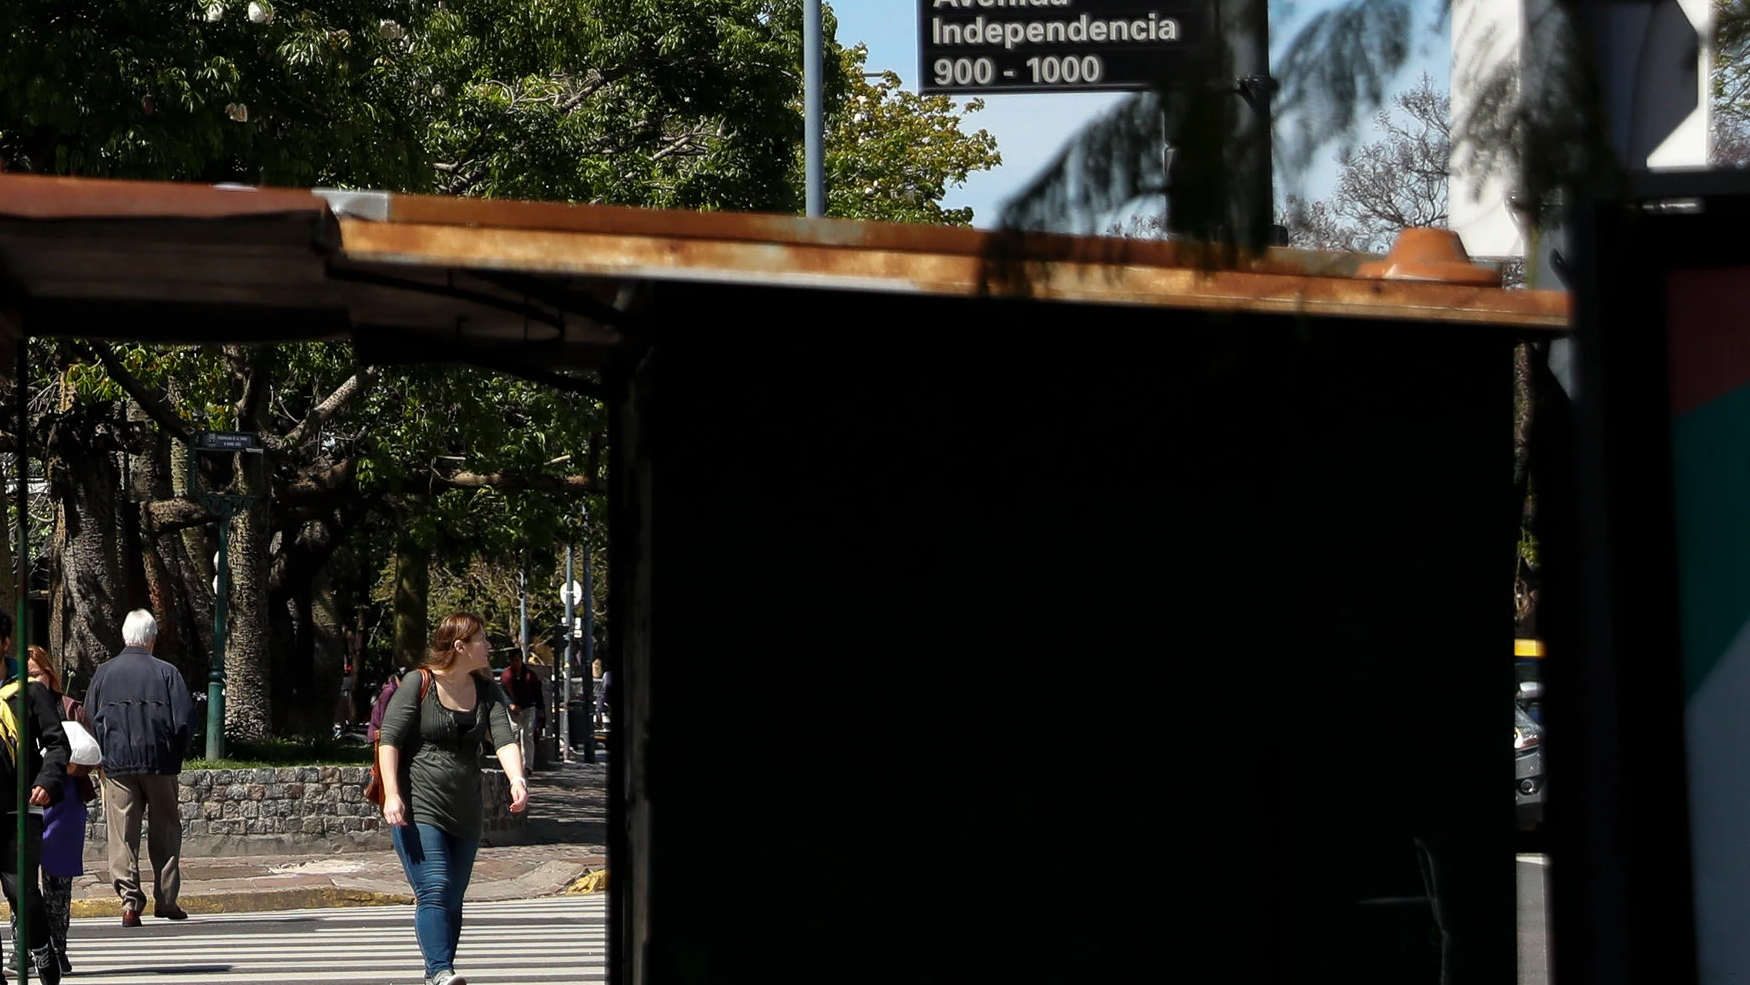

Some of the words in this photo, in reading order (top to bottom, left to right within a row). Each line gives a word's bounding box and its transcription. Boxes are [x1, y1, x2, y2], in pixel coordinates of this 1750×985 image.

[932, 13, 1178, 50] Independencia
[933, 56, 993, 86] 900
[1026, 55, 1101, 84] 1000
